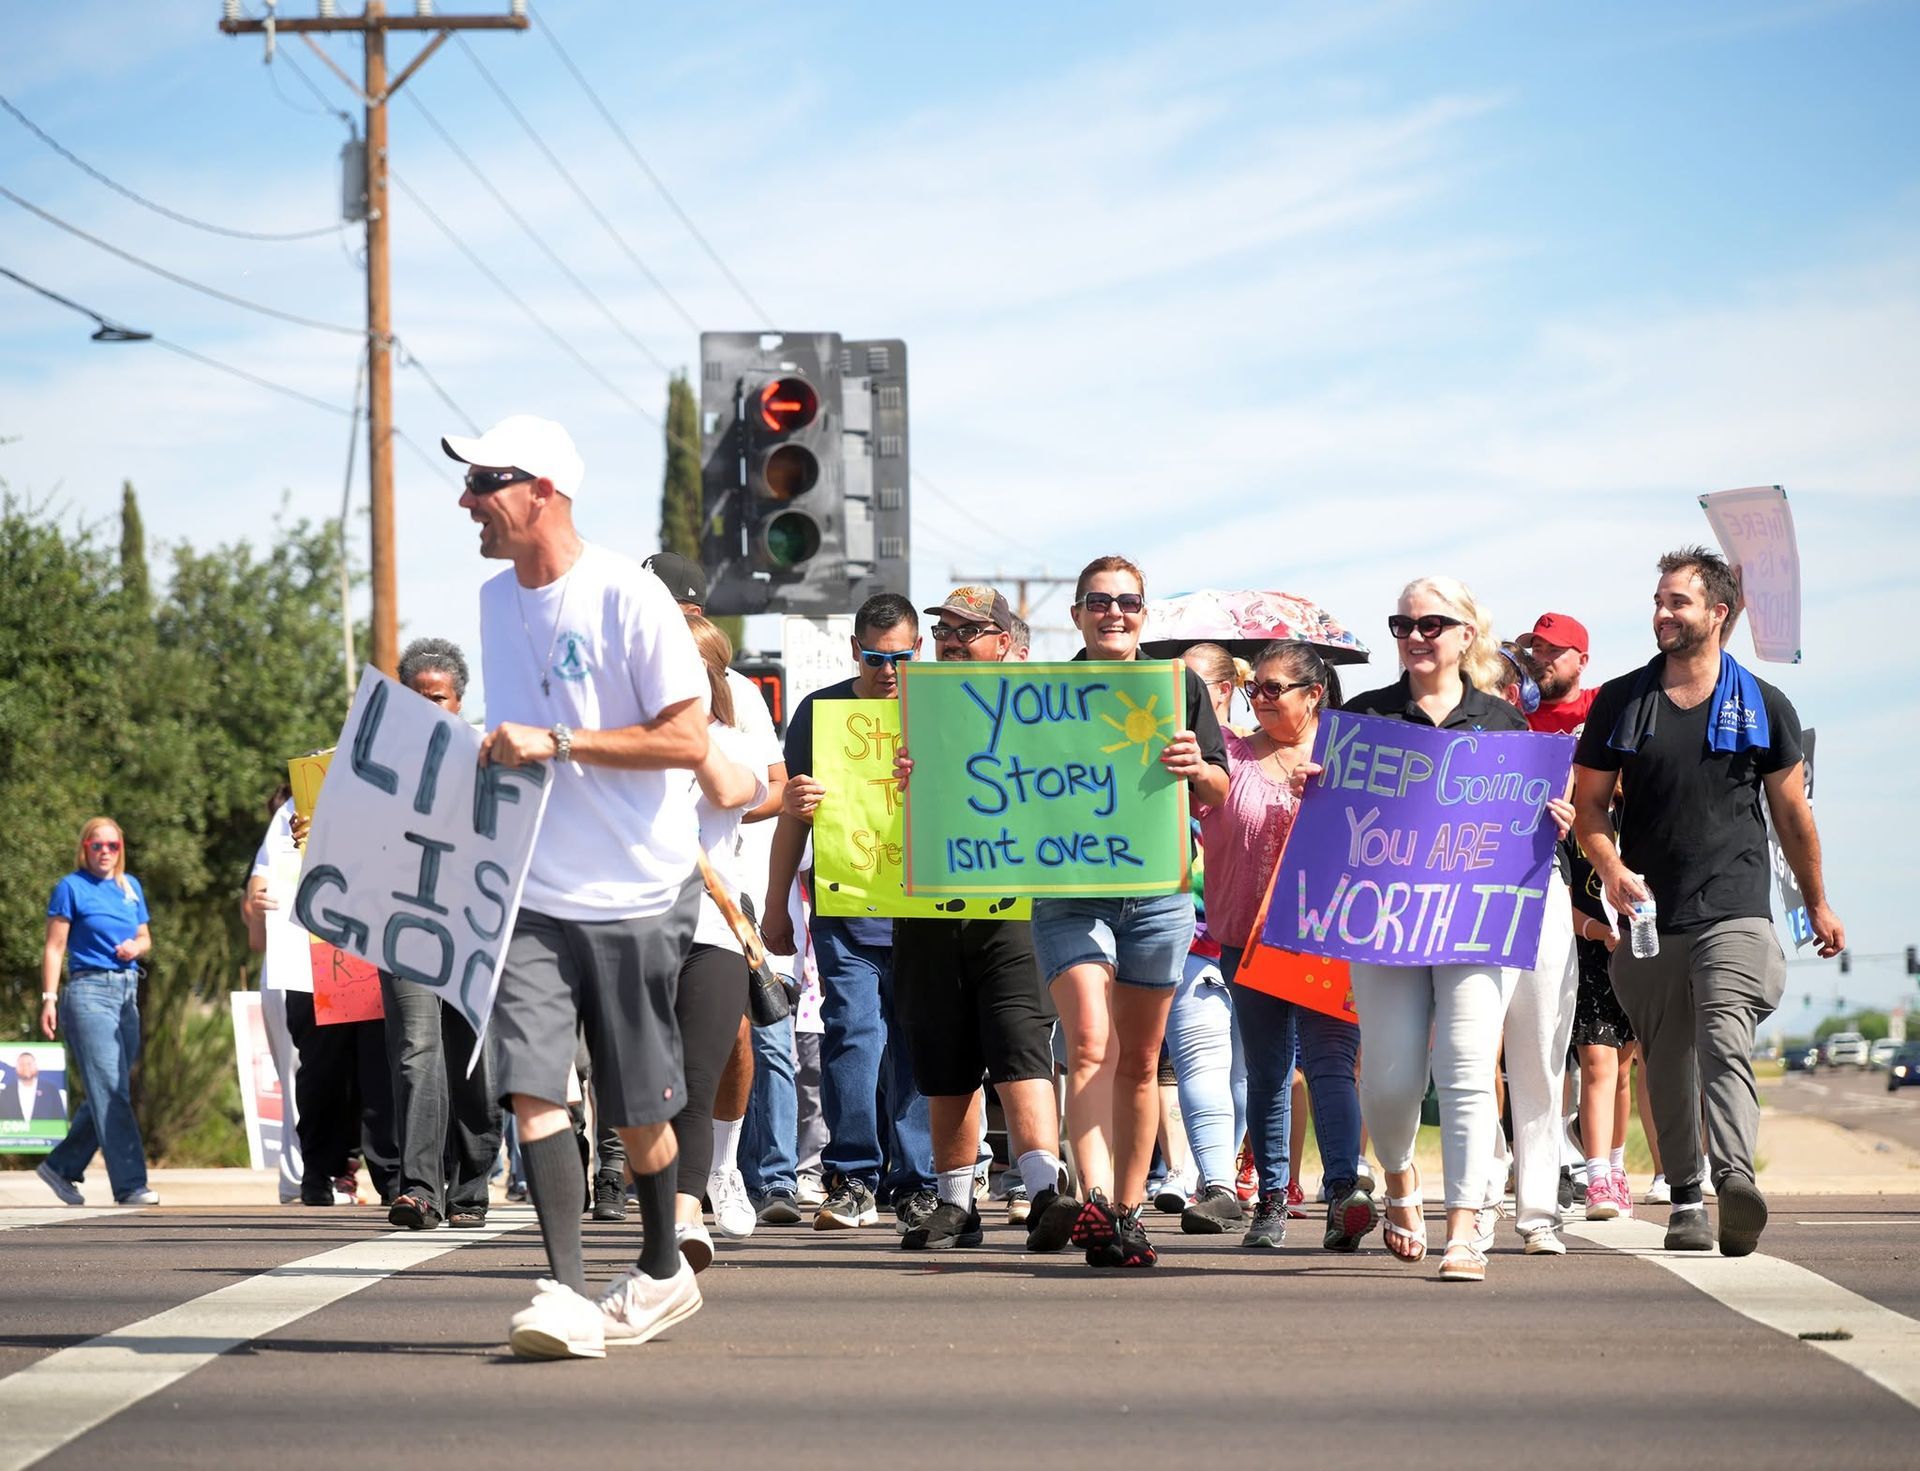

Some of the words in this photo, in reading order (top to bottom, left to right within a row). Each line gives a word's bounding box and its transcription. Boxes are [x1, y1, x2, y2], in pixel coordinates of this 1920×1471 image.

[1318, 715, 1434, 798] KEEP
[1436, 736, 1551, 836] Going
[391, 830, 510, 942] IS
[1425, 823, 1502, 872] ARE
[1297, 869, 1460, 957] WORTH
[1454, 884, 1544, 956] IT
